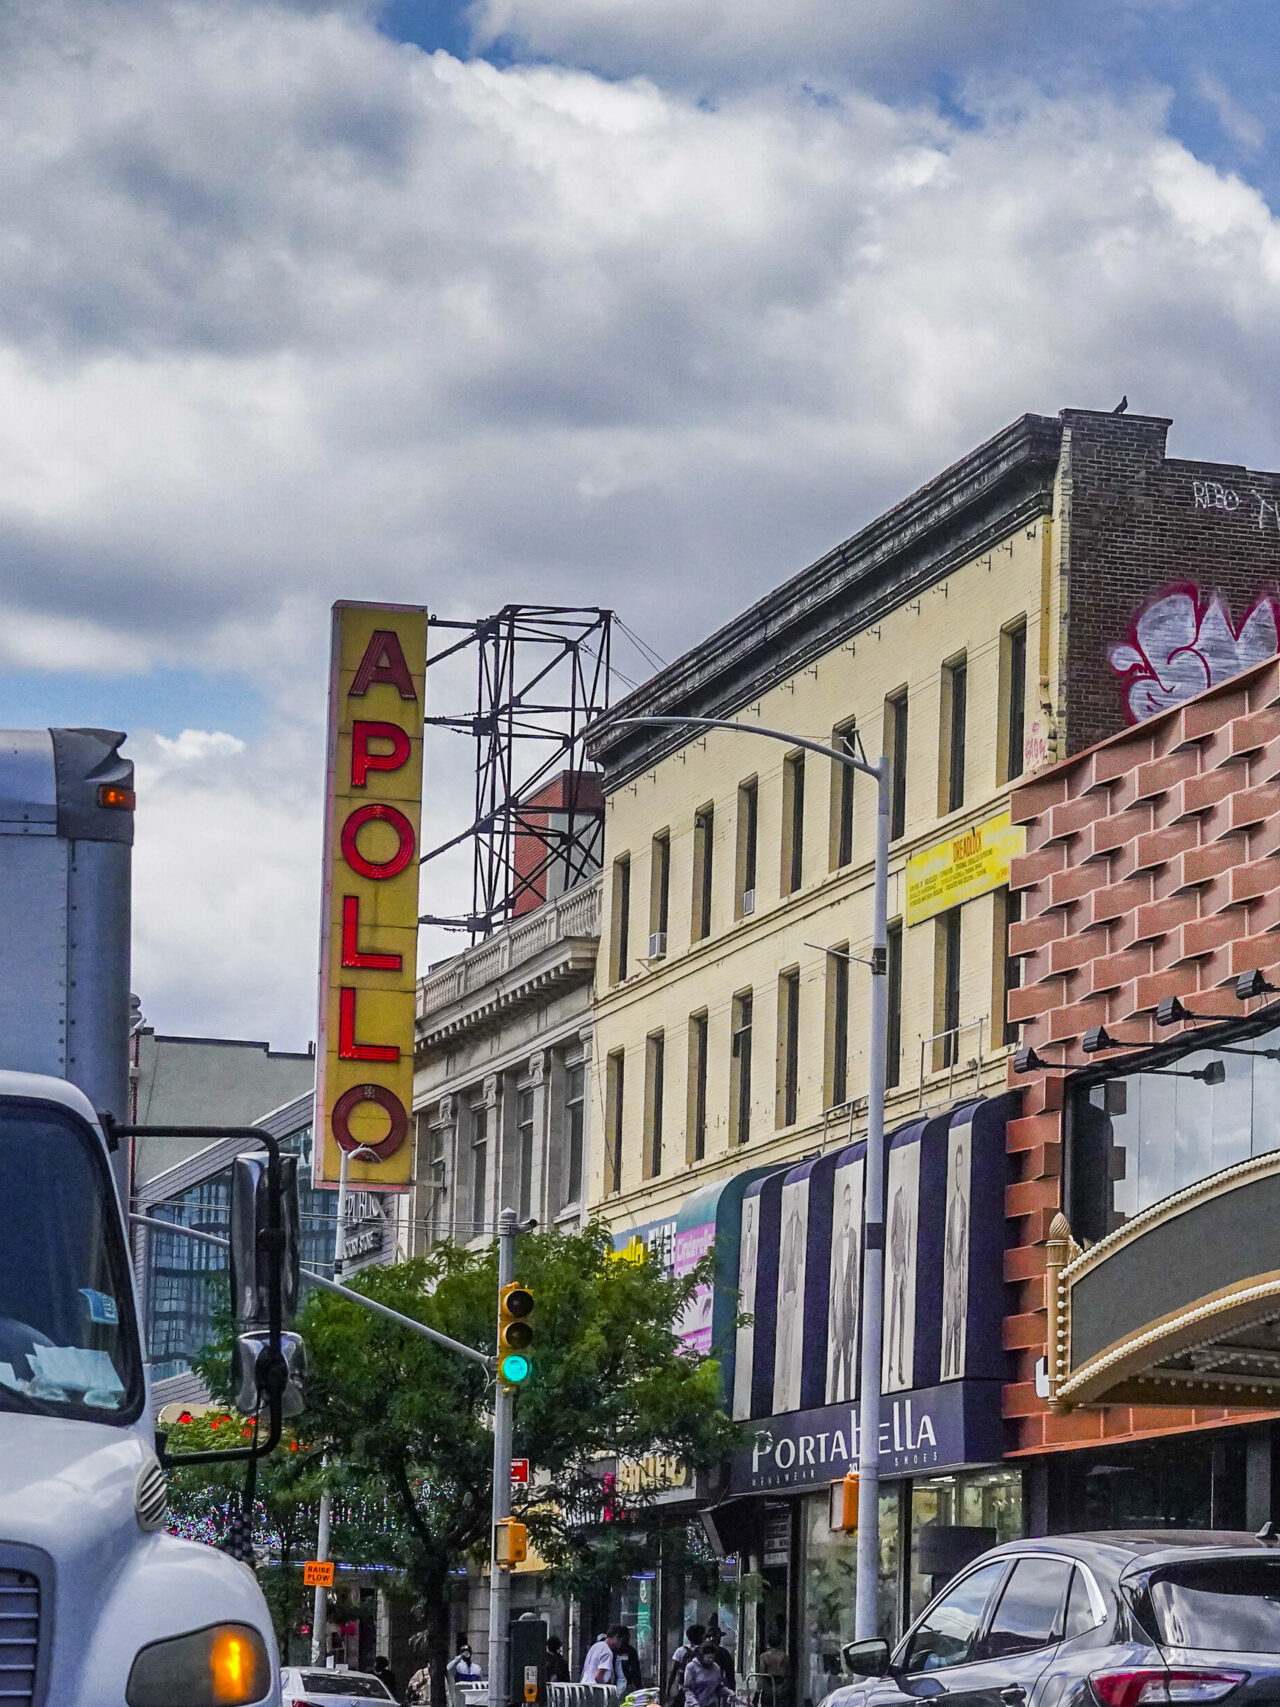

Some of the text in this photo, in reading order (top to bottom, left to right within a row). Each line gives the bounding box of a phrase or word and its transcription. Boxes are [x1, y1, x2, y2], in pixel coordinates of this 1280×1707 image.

[331, 629, 418, 1163] APOLLO
[894, 1451, 938, 1467] SHOES
[307, 1565, 331, 1574] RAISE
[307, 1574, 330, 1582] PLOW
